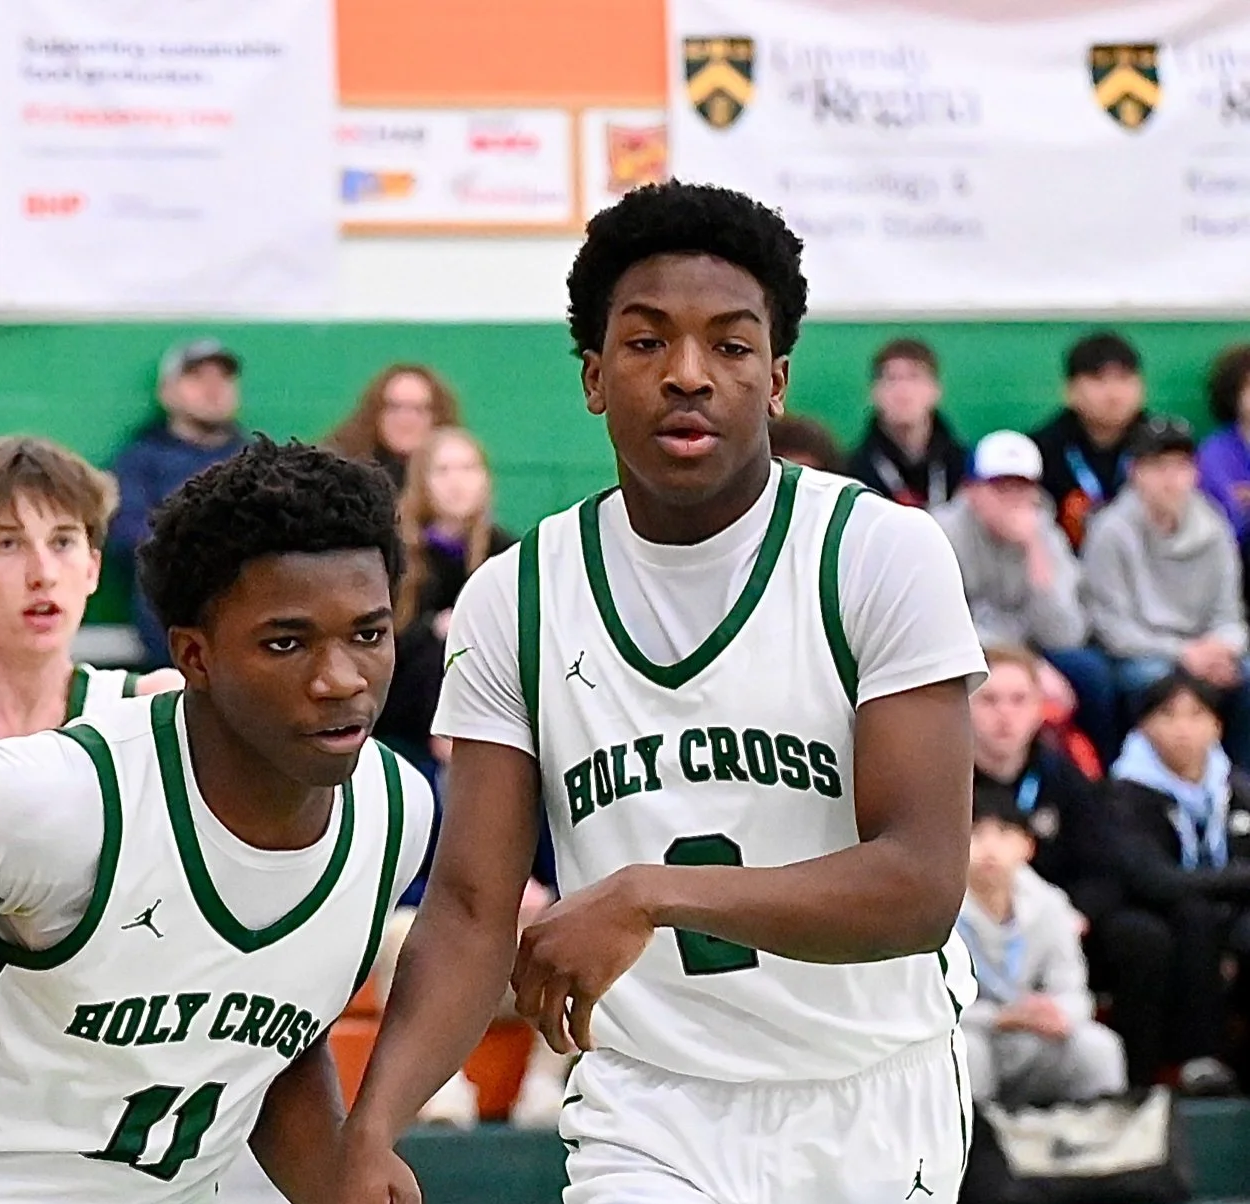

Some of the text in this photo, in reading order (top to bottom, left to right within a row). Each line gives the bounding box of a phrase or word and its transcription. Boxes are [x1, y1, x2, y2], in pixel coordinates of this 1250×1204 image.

[563, 726, 844, 828] HOLY CROSS
[63, 992, 212, 1047] HOLY
[78, 1081, 228, 1183] 11
